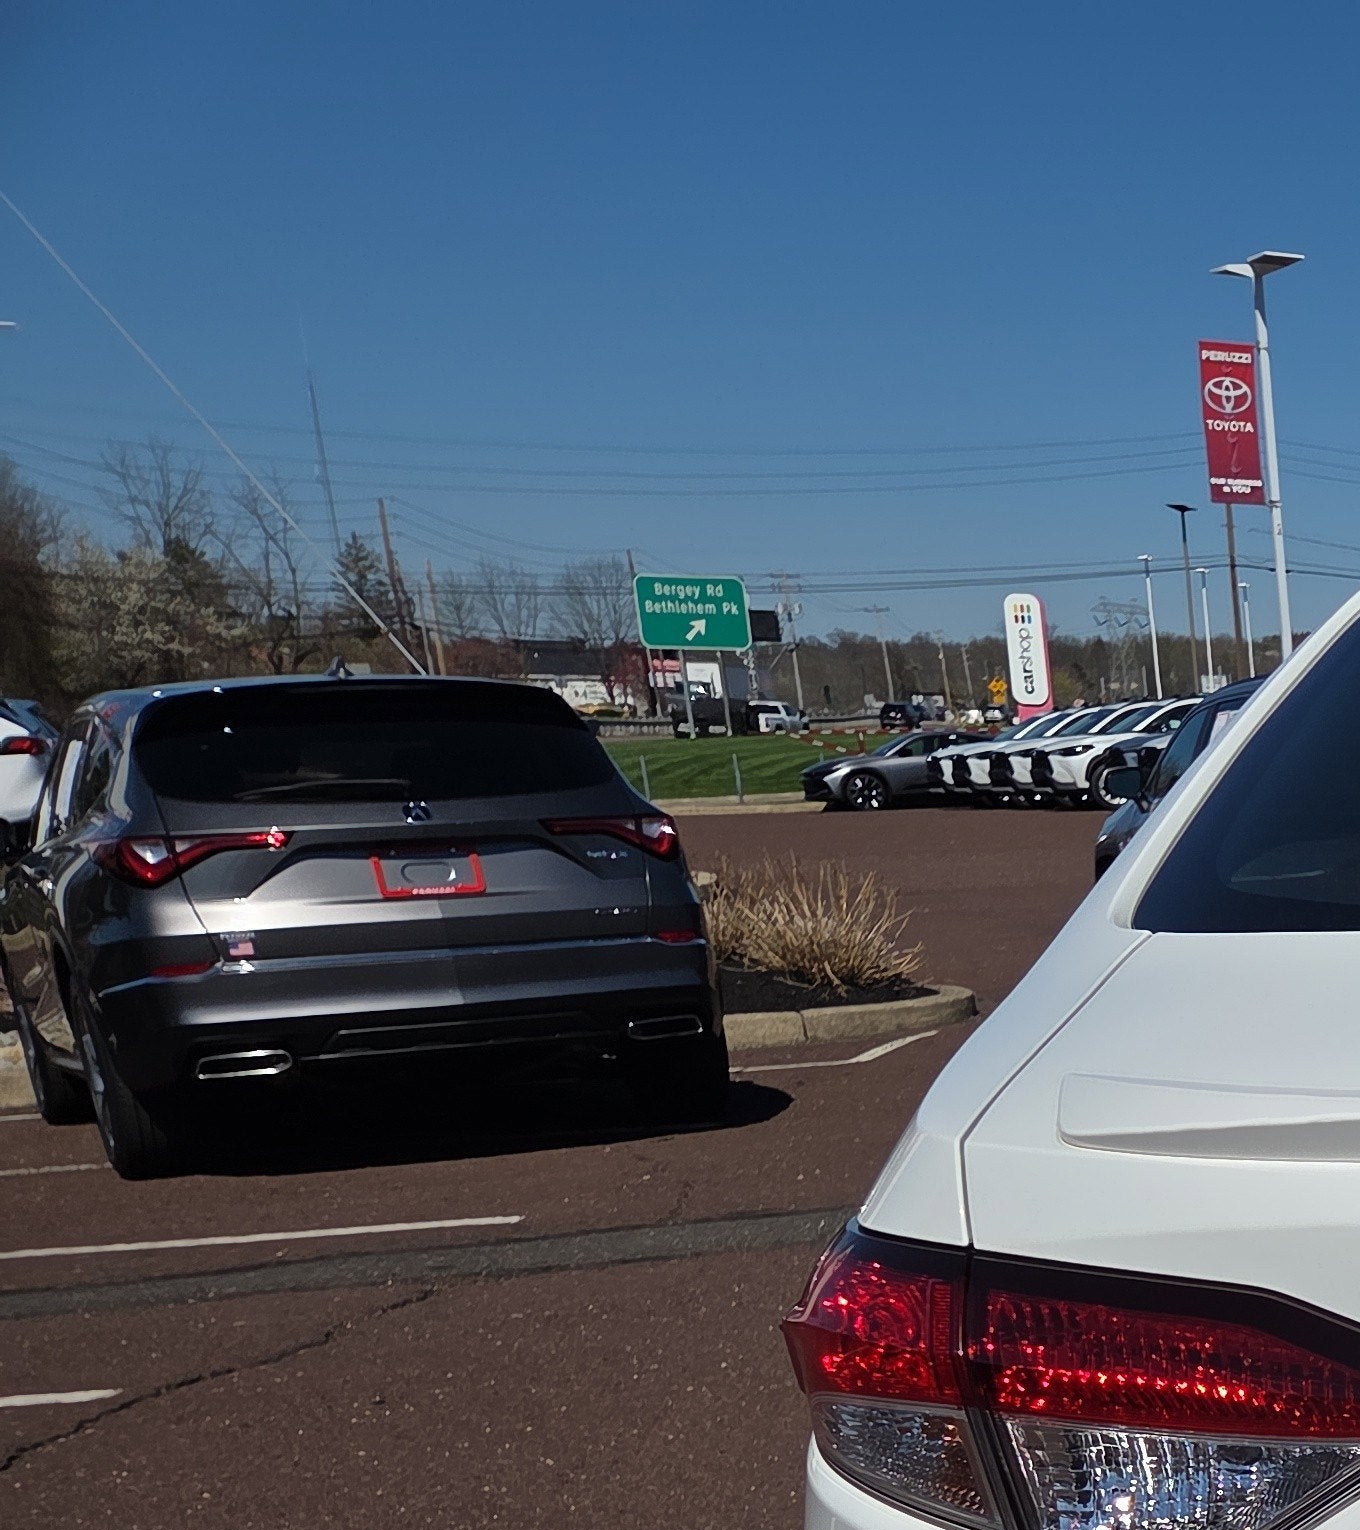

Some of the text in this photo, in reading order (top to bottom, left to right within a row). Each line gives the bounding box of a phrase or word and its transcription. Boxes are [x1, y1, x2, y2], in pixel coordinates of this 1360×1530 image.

[1206, 420, 1254, 433] TOYOTA
[654, 582, 724, 599] Bergey Rd
[645, 599, 739, 615] Bethlehem Pk
[1018, 627, 1035, 695] carshop
